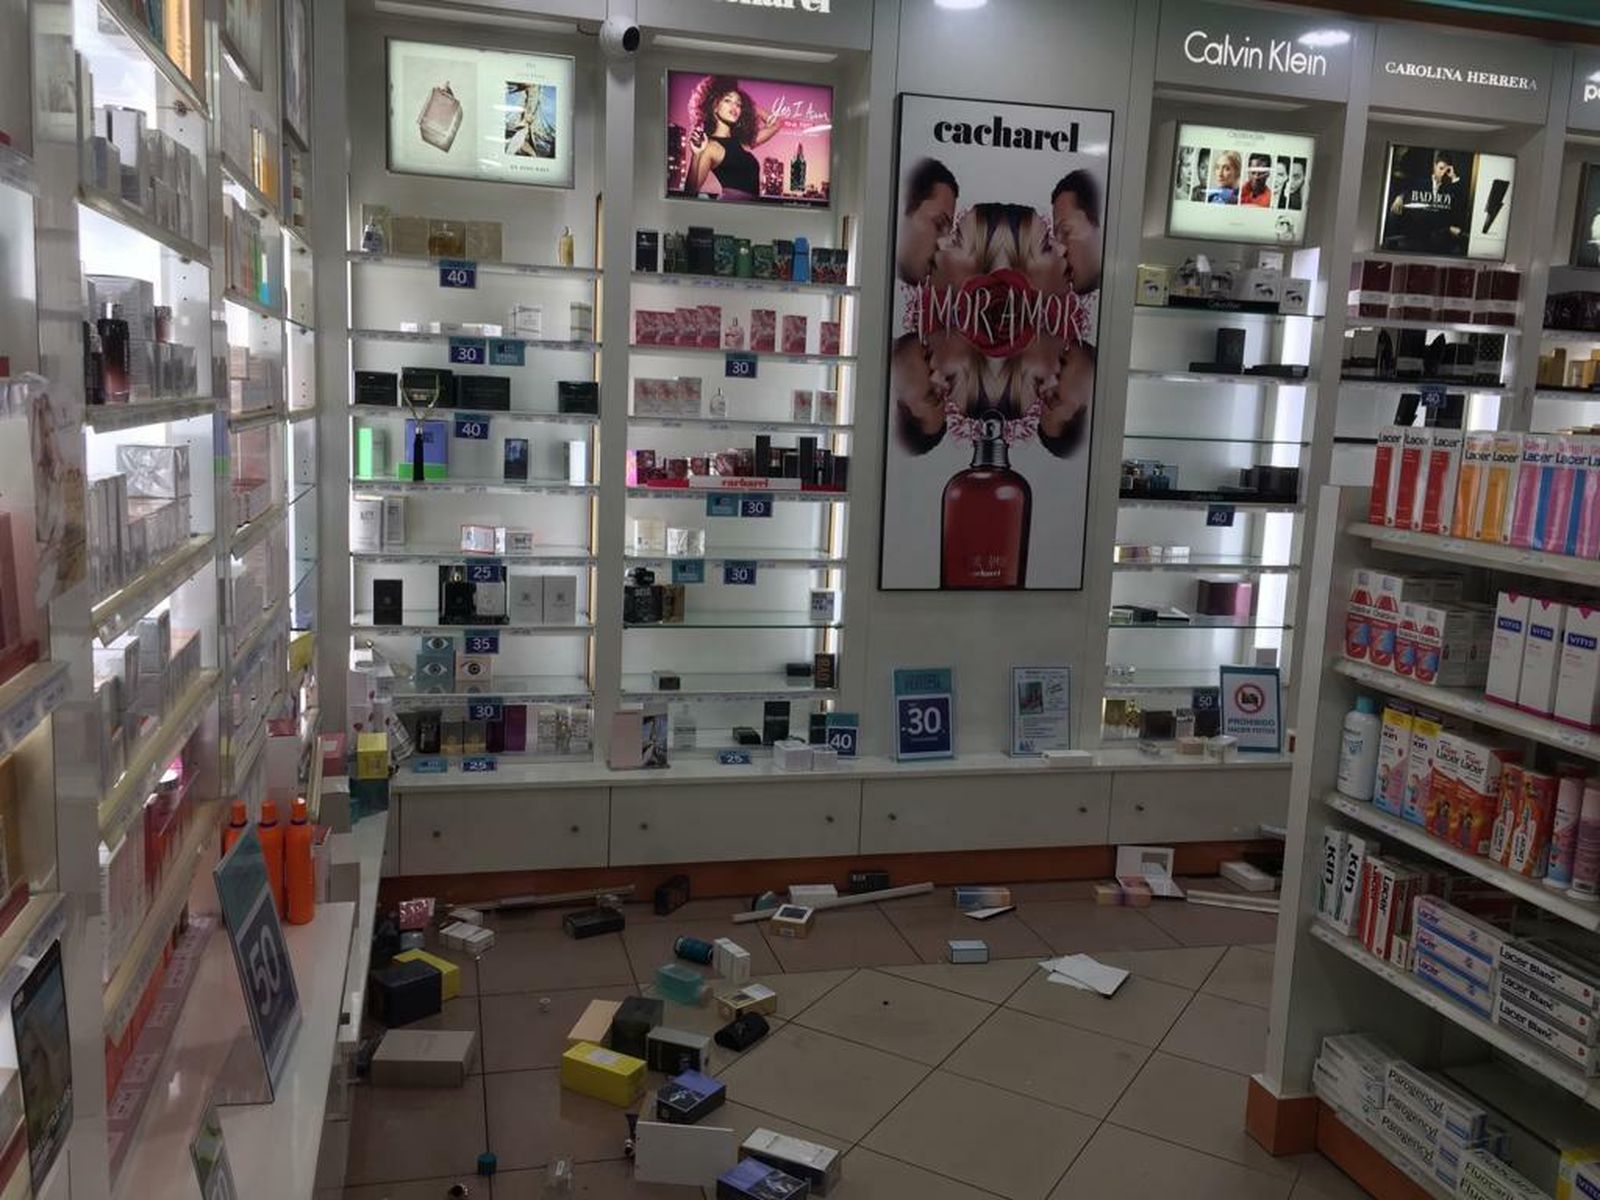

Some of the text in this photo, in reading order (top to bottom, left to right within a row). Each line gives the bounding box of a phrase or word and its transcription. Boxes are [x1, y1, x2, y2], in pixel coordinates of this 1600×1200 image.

[1184, 30, 1327, 76] Calvin Klein
[1385, 61, 1538, 91] CAROLINA HERRERA
[933, 116, 1079, 153] cacharel
[447, 270, 467, 284] 40
[915, 276, 1083, 350] AMOR AMOR
[457, 347, 477, 361] 30
[731, 361, 750, 375] 30
[462, 422, 481, 437] 40
[1379, 432, 1402, 443] Lacer
[1433, 436, 1460, 448] Lacer
[1464, 449, 1491, 461] Lacer
[1493, 451, 1519, 463] Lacer
[1523, 450, 1553, 463] Lacer
[1555, 453, 1588, 466] Lacer
[747, 501, 765, 514] 30
[1211, 512, 1227, 523] 40
[473, 566, 491, 579] 25
[731, 569, 748, 581] 30
[472, 638, 490, 651] 35
[475, 704, 495, 718] 30
[907, 706, 942, 735] 30
[831, 733, 852, 749] 40
[1379, 874, 1393, 917] Lacer
[249, 923, 282, 1017] 50
[1501, 945, 1557, 984] Lacer Blanc
[1501, 972, 1554, 1012] Lacer Blanc
[1500, 1000, 1554, 1041] Lacer Blanc
[1388, 1068, 1445, 1113] Parogencyl
[1388, 1093, 1440, 1137] Parogencyl
[1382, 1115, 1435, 1162] Parogencyl
